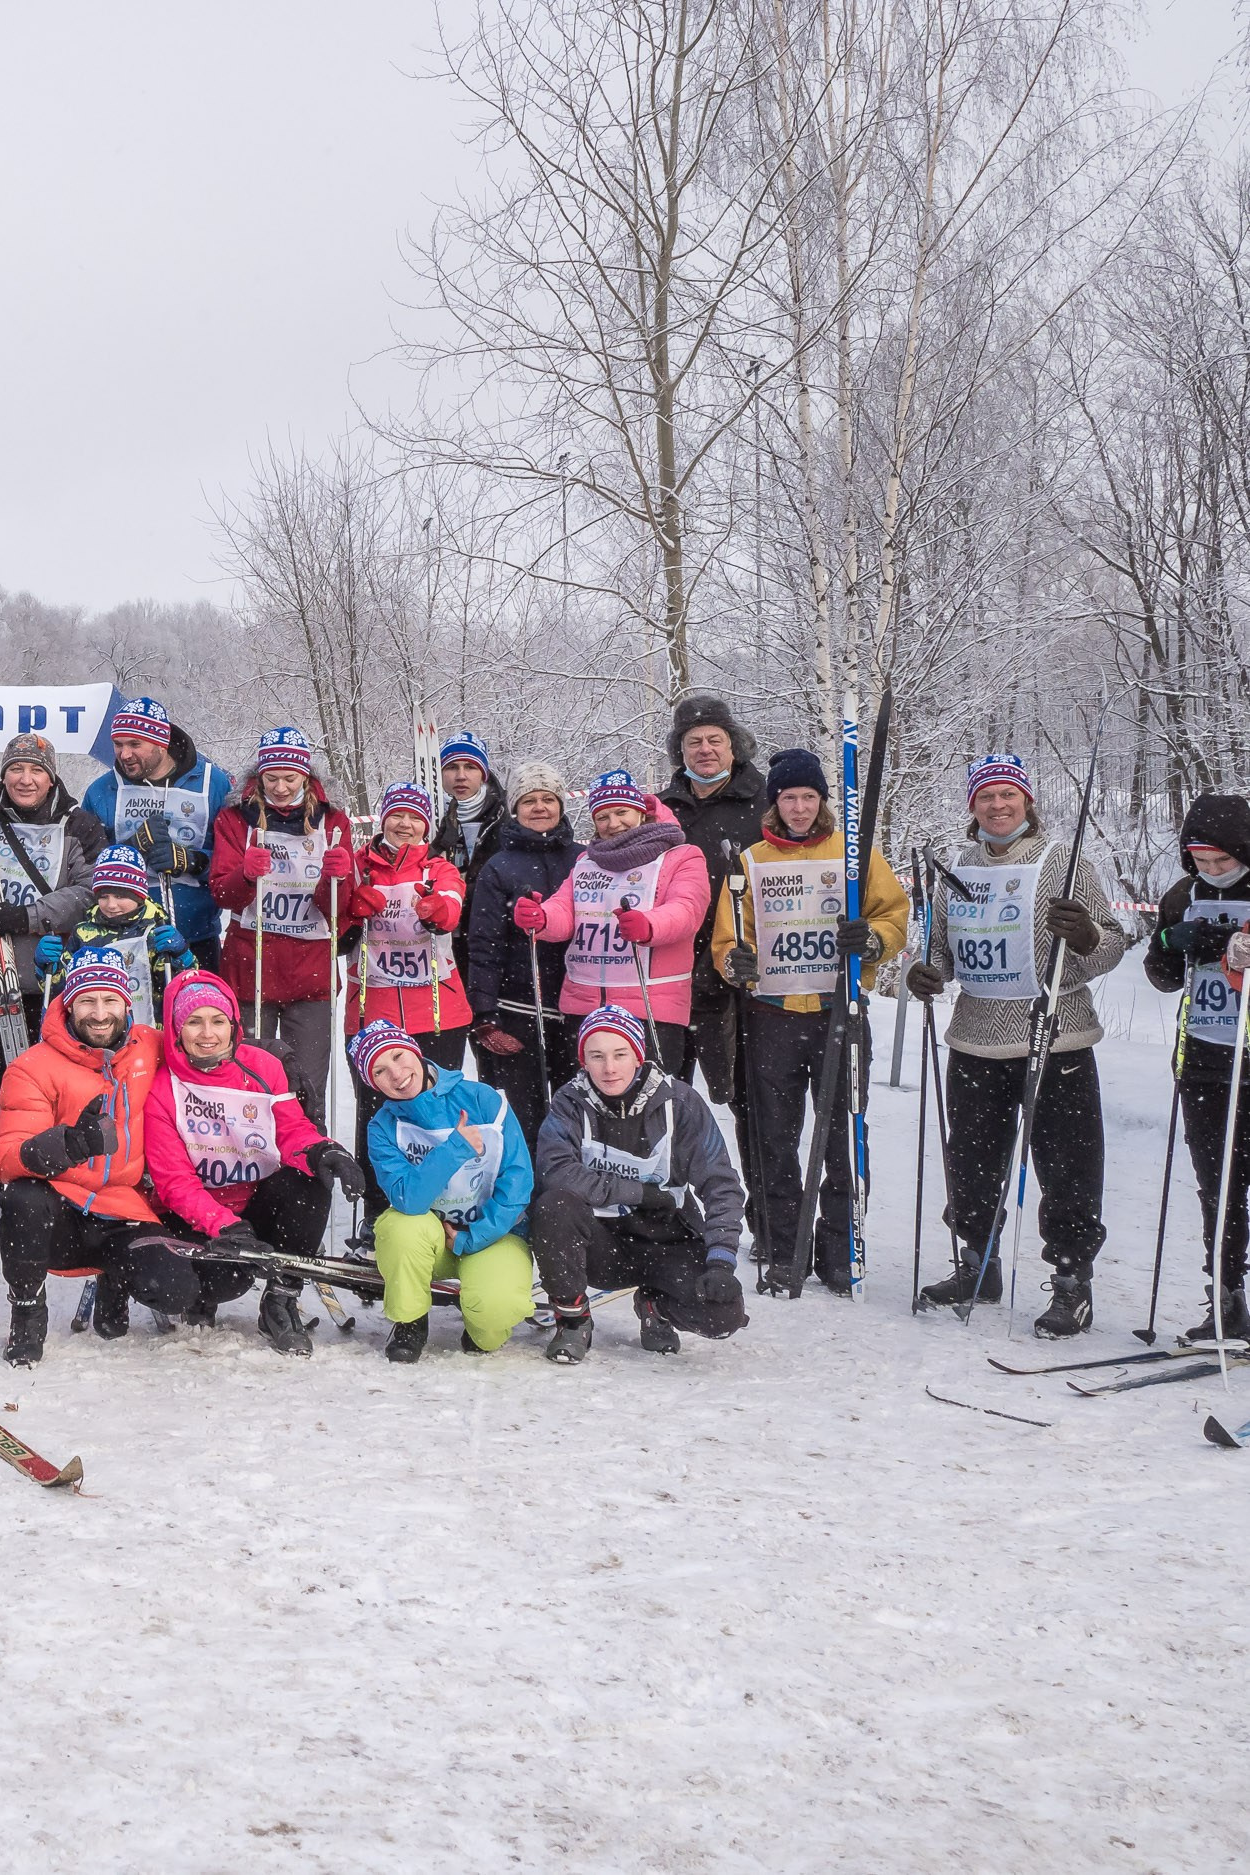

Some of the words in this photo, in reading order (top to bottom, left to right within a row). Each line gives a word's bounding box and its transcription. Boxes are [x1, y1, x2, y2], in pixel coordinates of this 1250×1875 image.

[431, 756, 440, 830] ADSHUS
[125, 798, 165, 808] ЛЫЖНЯ
[846, 785, 860, 870] NORDWAY
[575, 881, 610, 890] РОССИИ
[577, 871, 613, 883] ЛЫЖНЯ
[760, 875, 803, 887] ЛЫЖНЯ
[761, 886, 804, 898] РОССИИ
[963, 881, 991, 893] ЖНЯ
[262, 892, 314, 921] 4072
[574, 891, 604, 903] 2021
[764, 898, 802, 913] 2021
[948, 904, 985, 919] 2021
[575, 922, 629, 952] 4715
[771, 929, 836, 962] 4856
[957, 938, 1007, 970] 4831
[377, 949, 429, 979] 4551
[1033, 1011, 1046, 1052] NORDWAY
[186, 1119, 230, 1136] 2021
[195, 1158, 261, 1186] 4040
[588, 1157, 640, 1175] ЛЫЖНЯ
[852, 1199, 861, 1239] CLASSIC
[853, 1240, 863, 1261] XC
